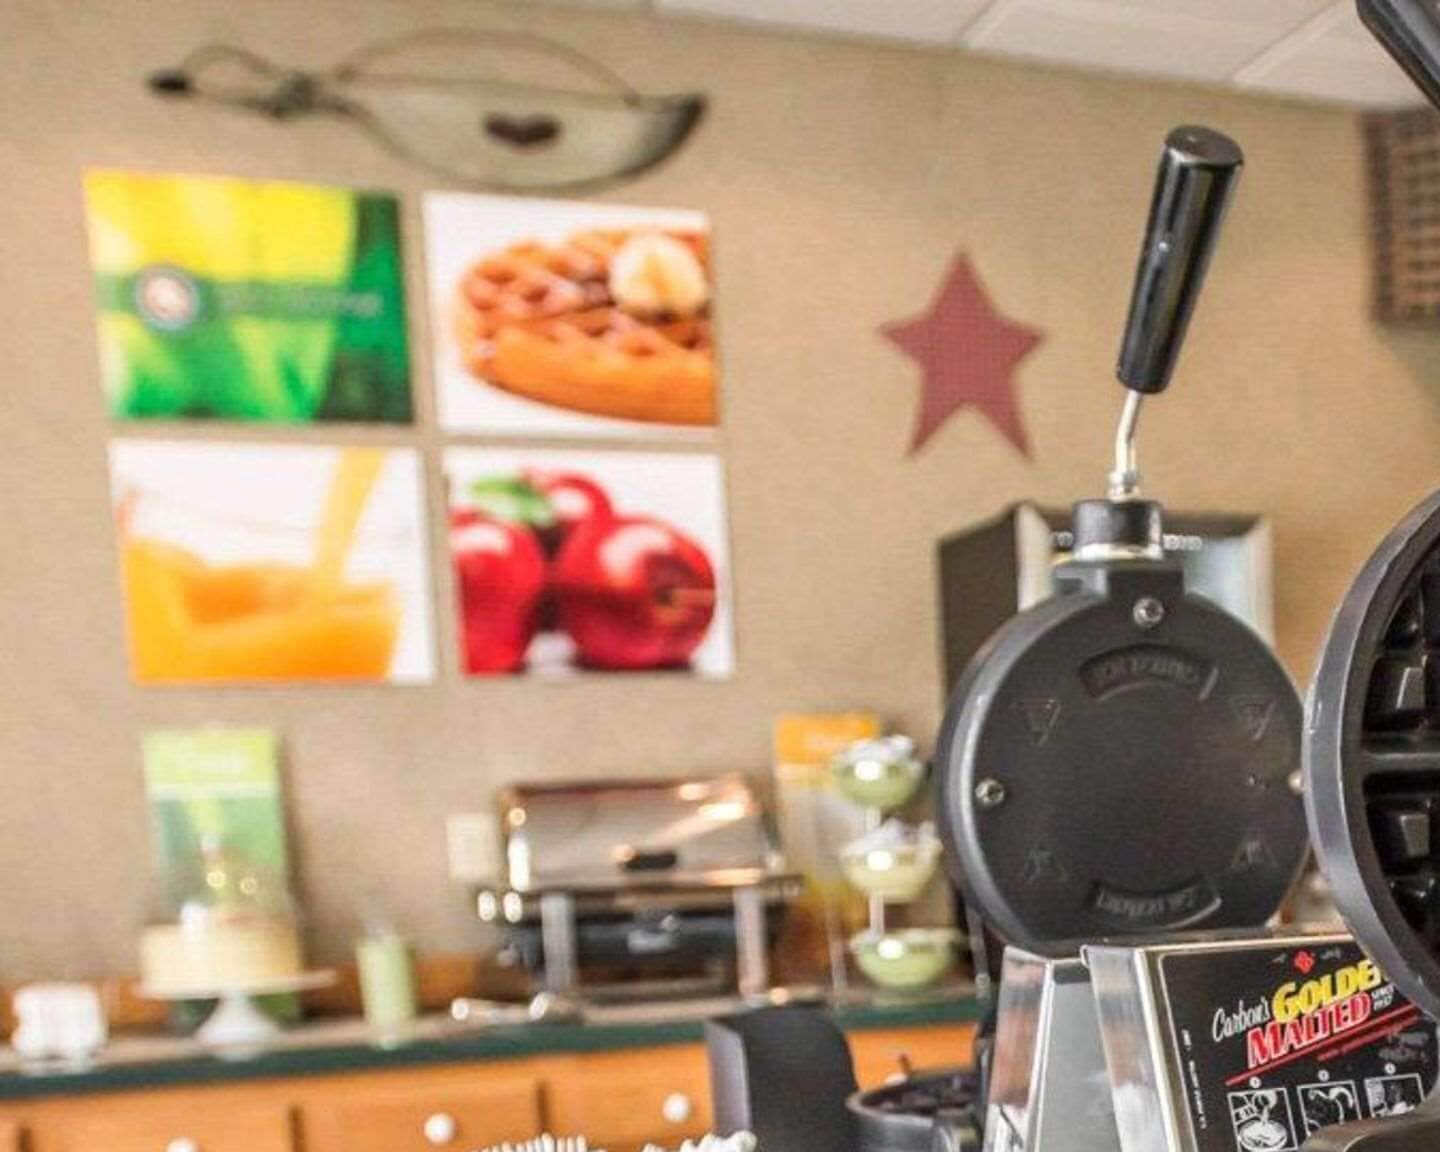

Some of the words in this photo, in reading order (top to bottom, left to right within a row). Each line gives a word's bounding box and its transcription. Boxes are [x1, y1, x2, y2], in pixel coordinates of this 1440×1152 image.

[1212, 996, 1271, 1043] Carbon's
[1271, 958, 1384, 1023] GOLDE
[1247, 990, 1372, 1070] MALTED
